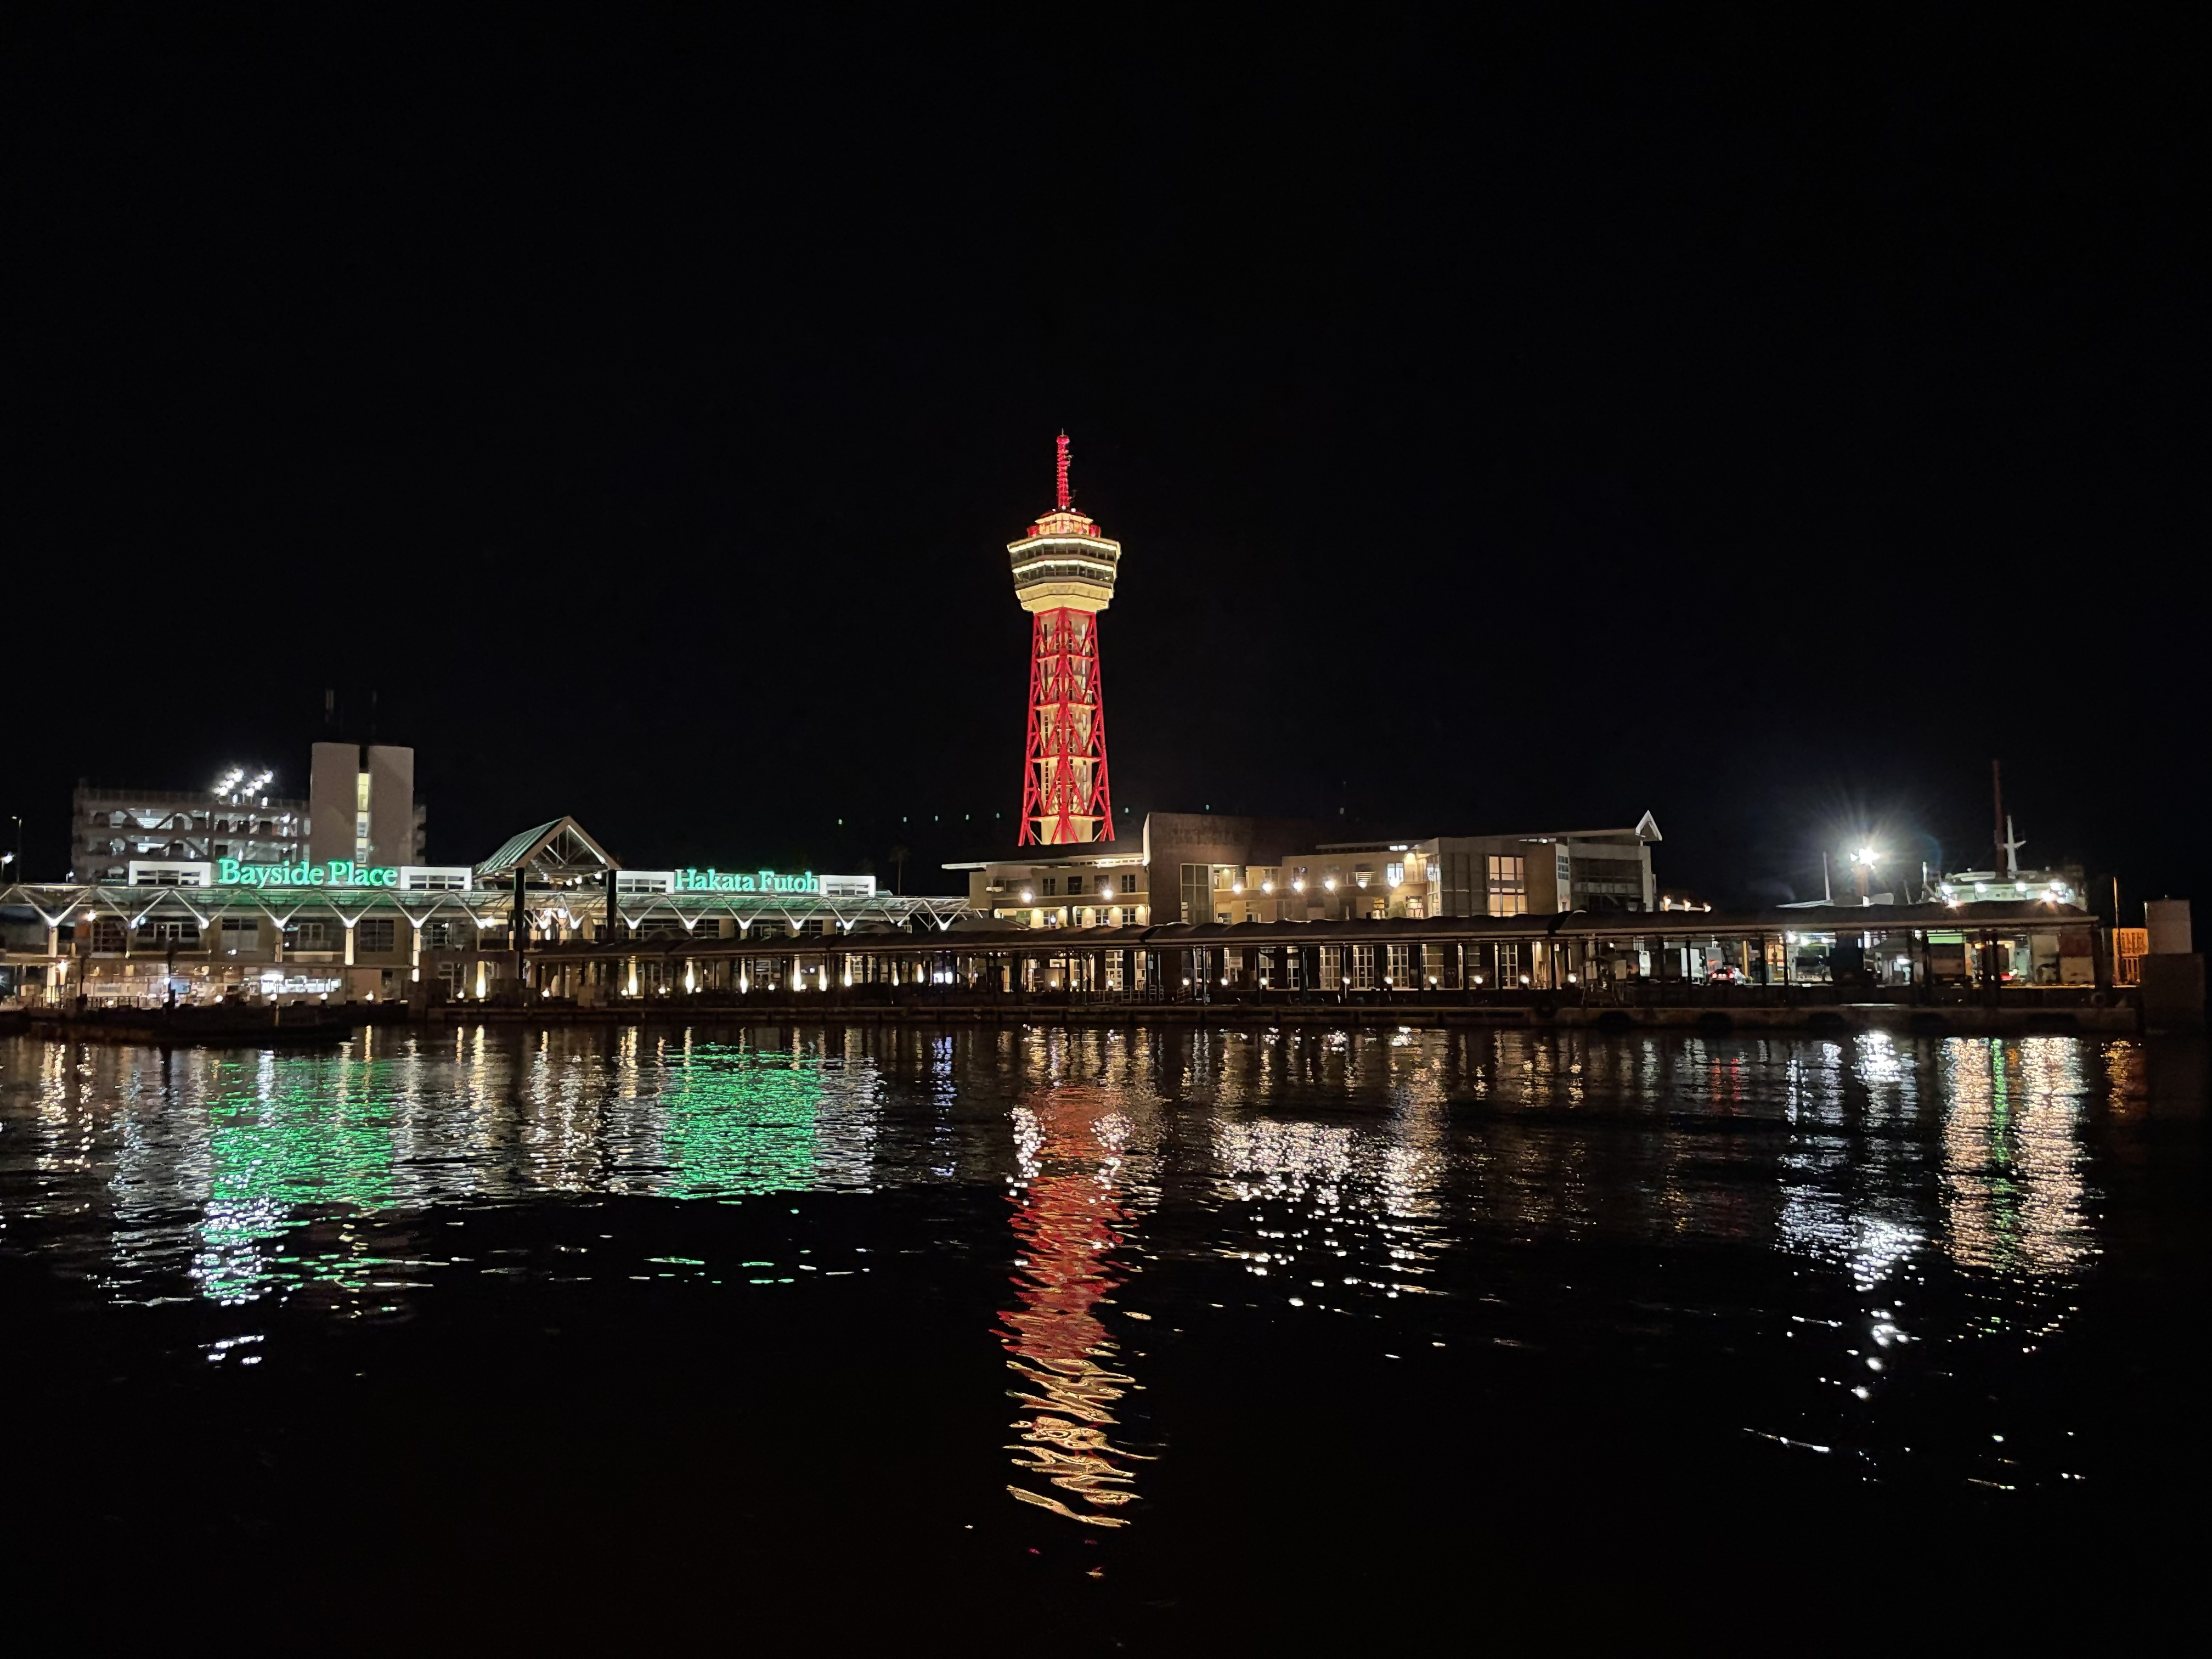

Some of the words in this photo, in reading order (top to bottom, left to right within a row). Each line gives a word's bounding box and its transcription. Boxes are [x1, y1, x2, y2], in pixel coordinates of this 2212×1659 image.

[218, 858, 325, 889] Bayside
[327, 860, 398, 887] Place
[674, 868, 756, 892] Hakata
[758, 870, 819, 893] Futoh
